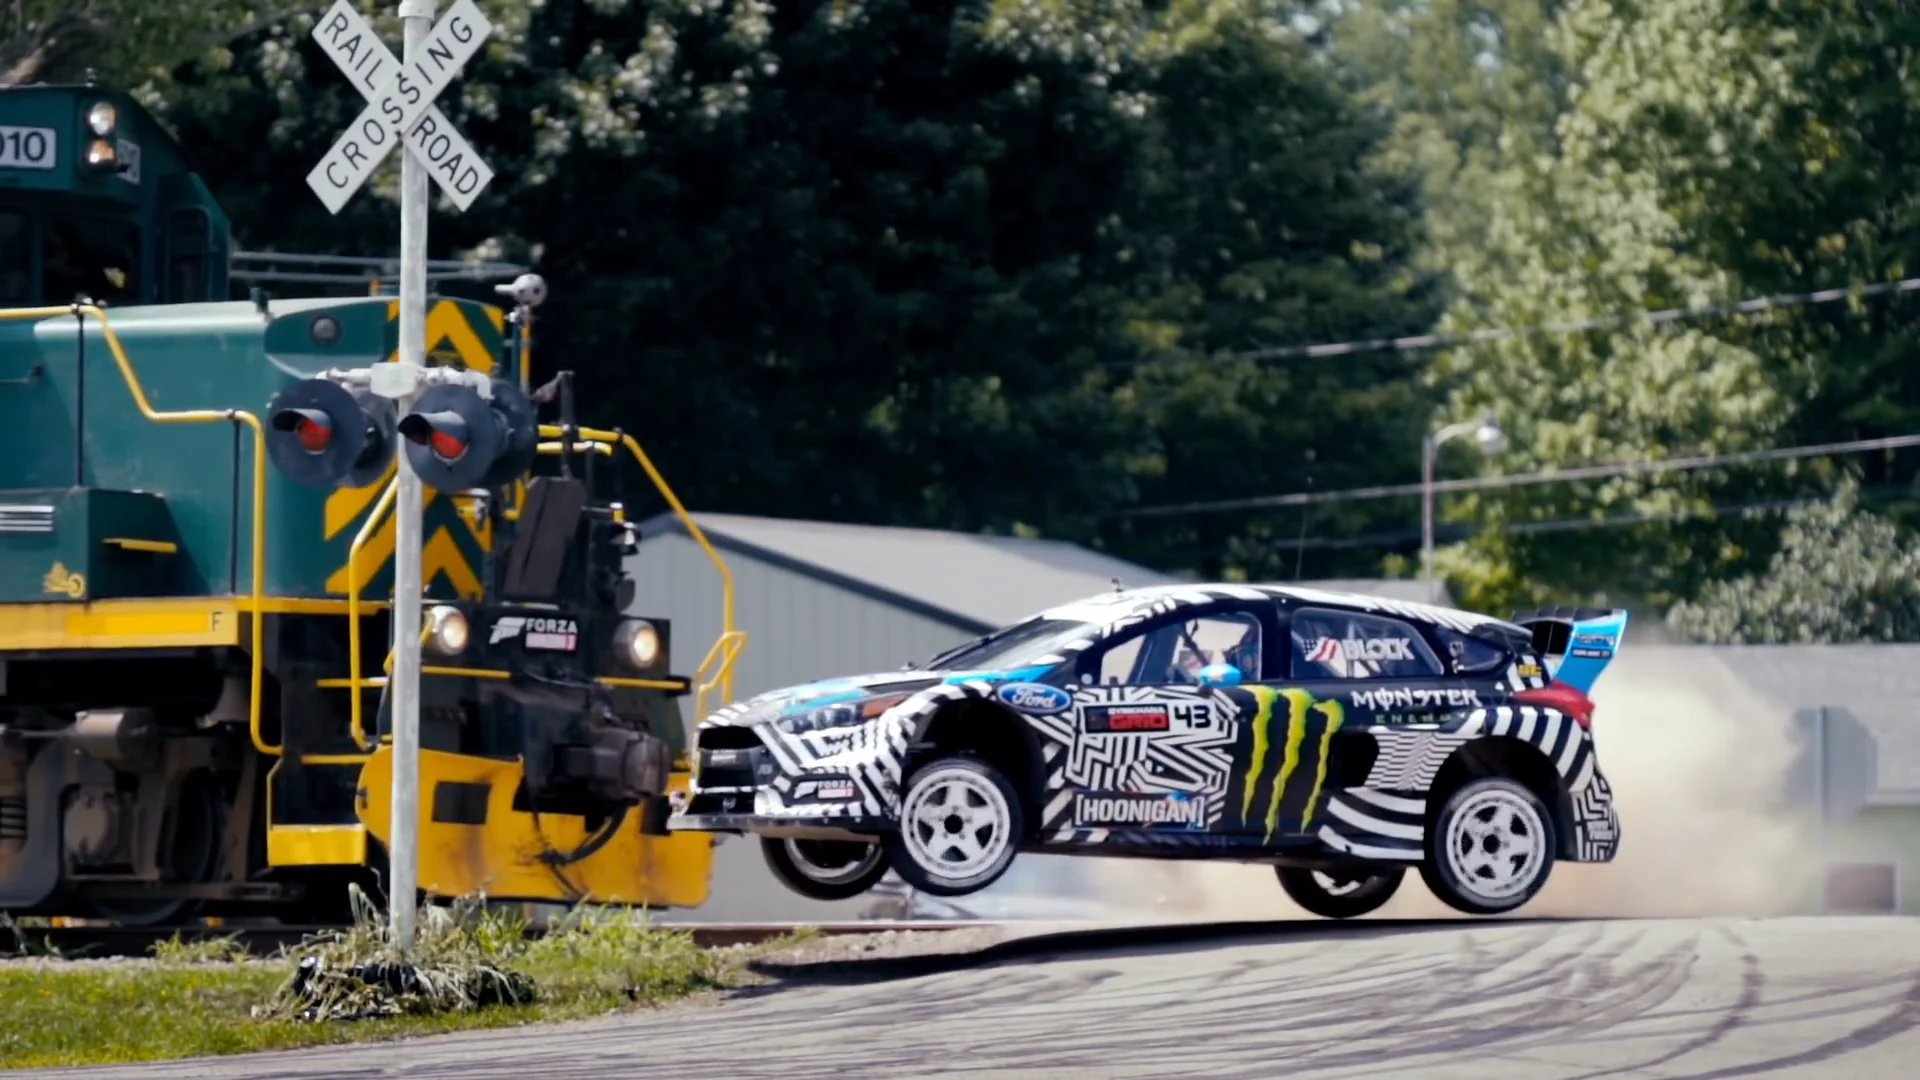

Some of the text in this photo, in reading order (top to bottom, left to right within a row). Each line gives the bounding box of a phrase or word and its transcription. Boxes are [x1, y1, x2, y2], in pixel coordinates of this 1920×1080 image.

[323, 11, 383, 91] RAIL
[326, 16, 473, 189] CROSSING
[0, 131, 47, 162] 10
[411, 114, 479, 195] ROAD
[525, 617, 578, 634] FORZA
[1340, 637, 1416, 661] BLOCK
[1012, 687, 1057, 709] Ford
[1350, 686, 1484, 712] MONSTER
[1174, 704, 1212, 729] 43
